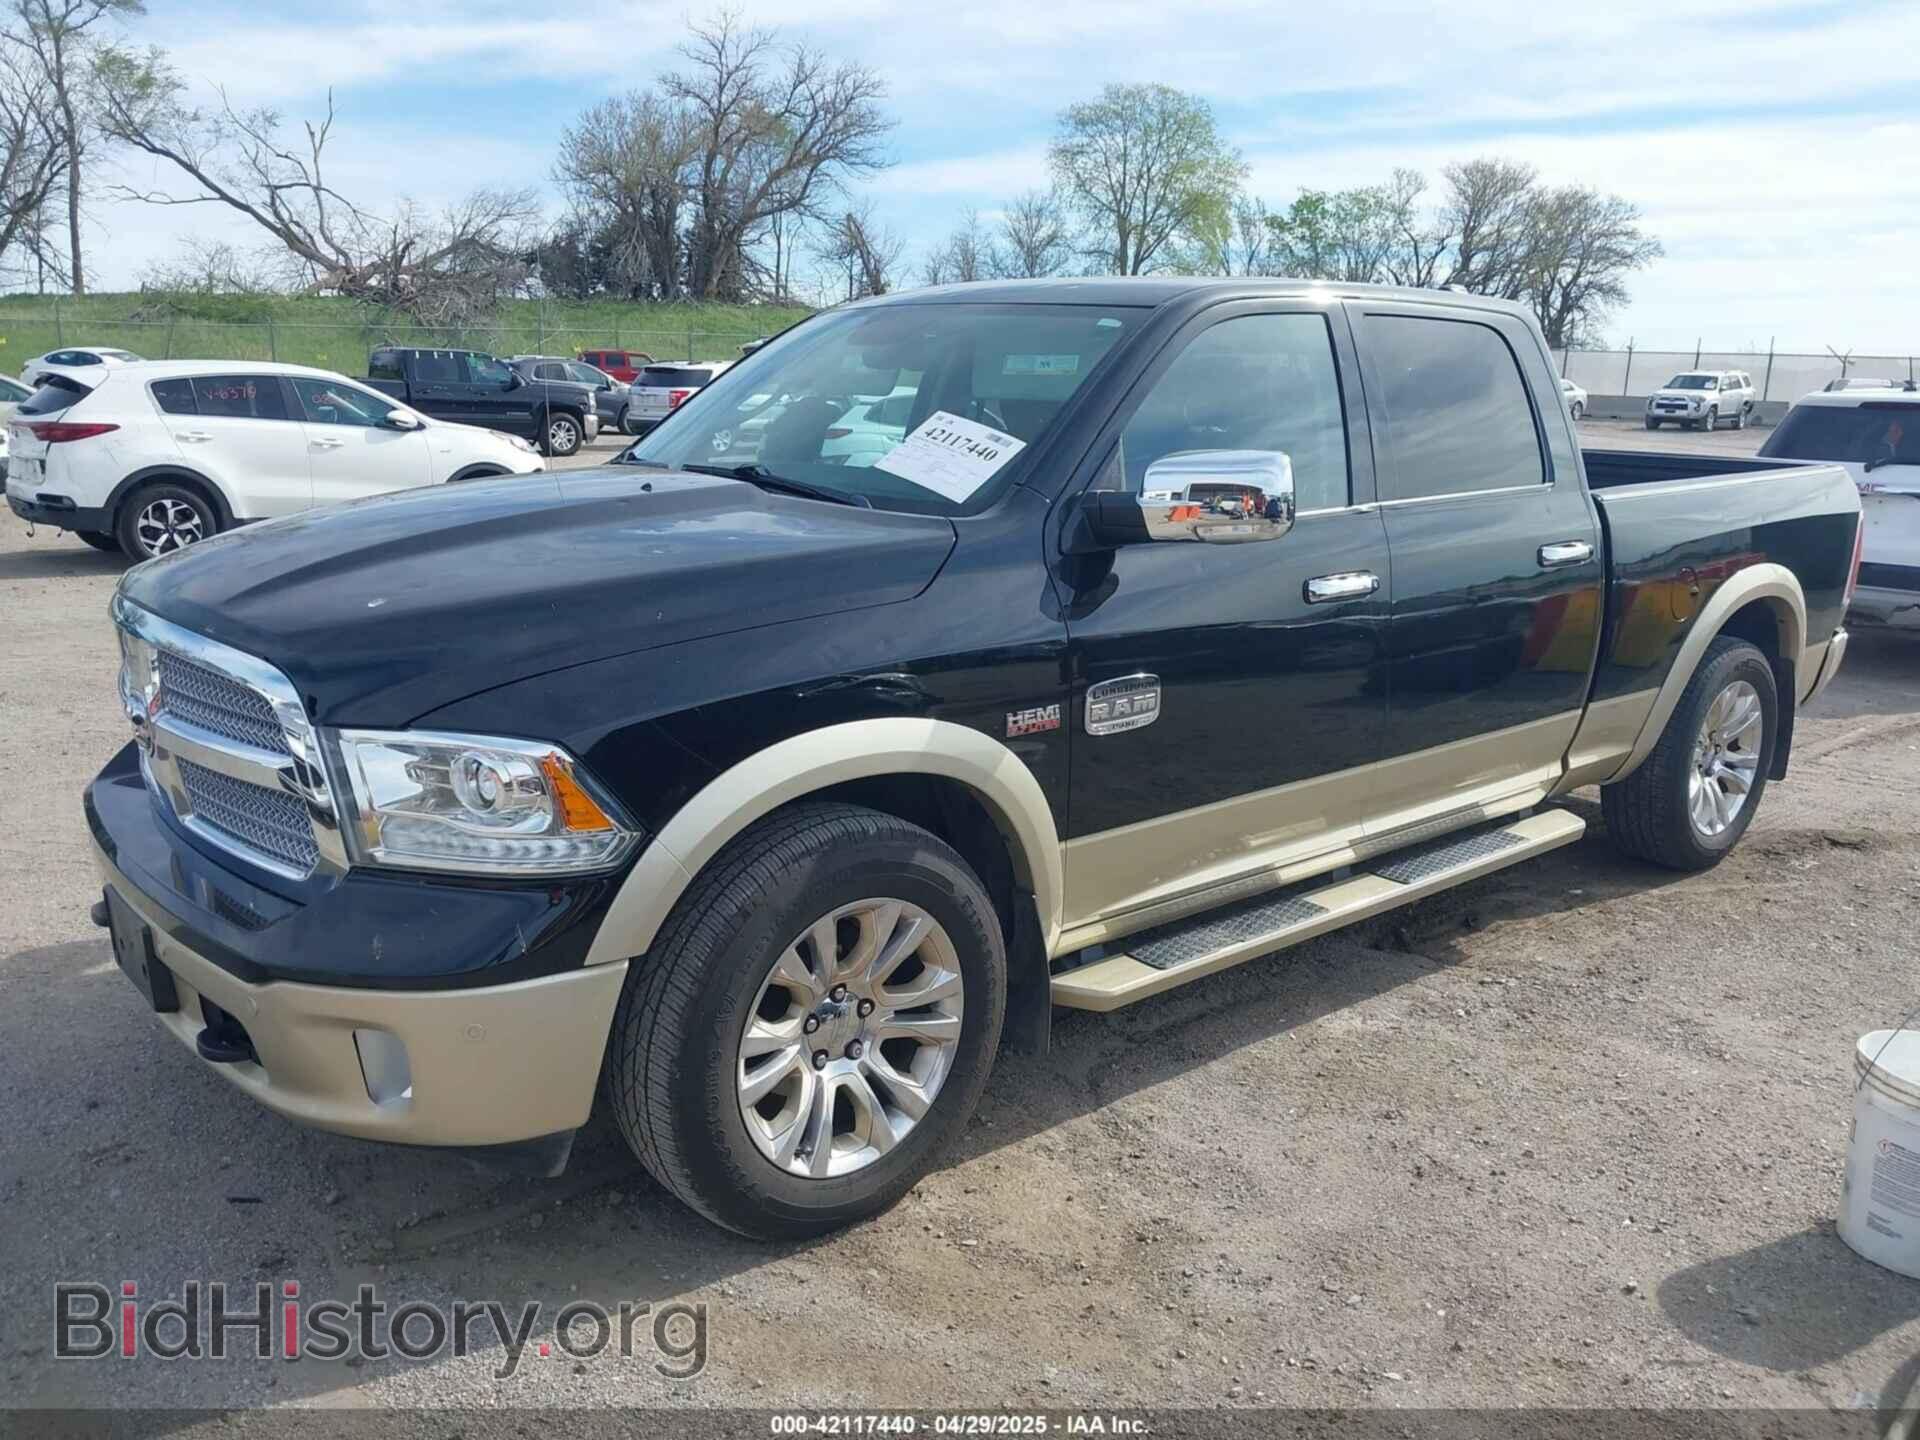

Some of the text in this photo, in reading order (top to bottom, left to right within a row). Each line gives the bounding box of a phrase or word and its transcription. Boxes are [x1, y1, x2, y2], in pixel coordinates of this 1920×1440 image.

[924, 427, 999, 462] 42117440
[1007, 704, 1060, 724] HEMI
[1091, 693, 1156, 720] RAM
